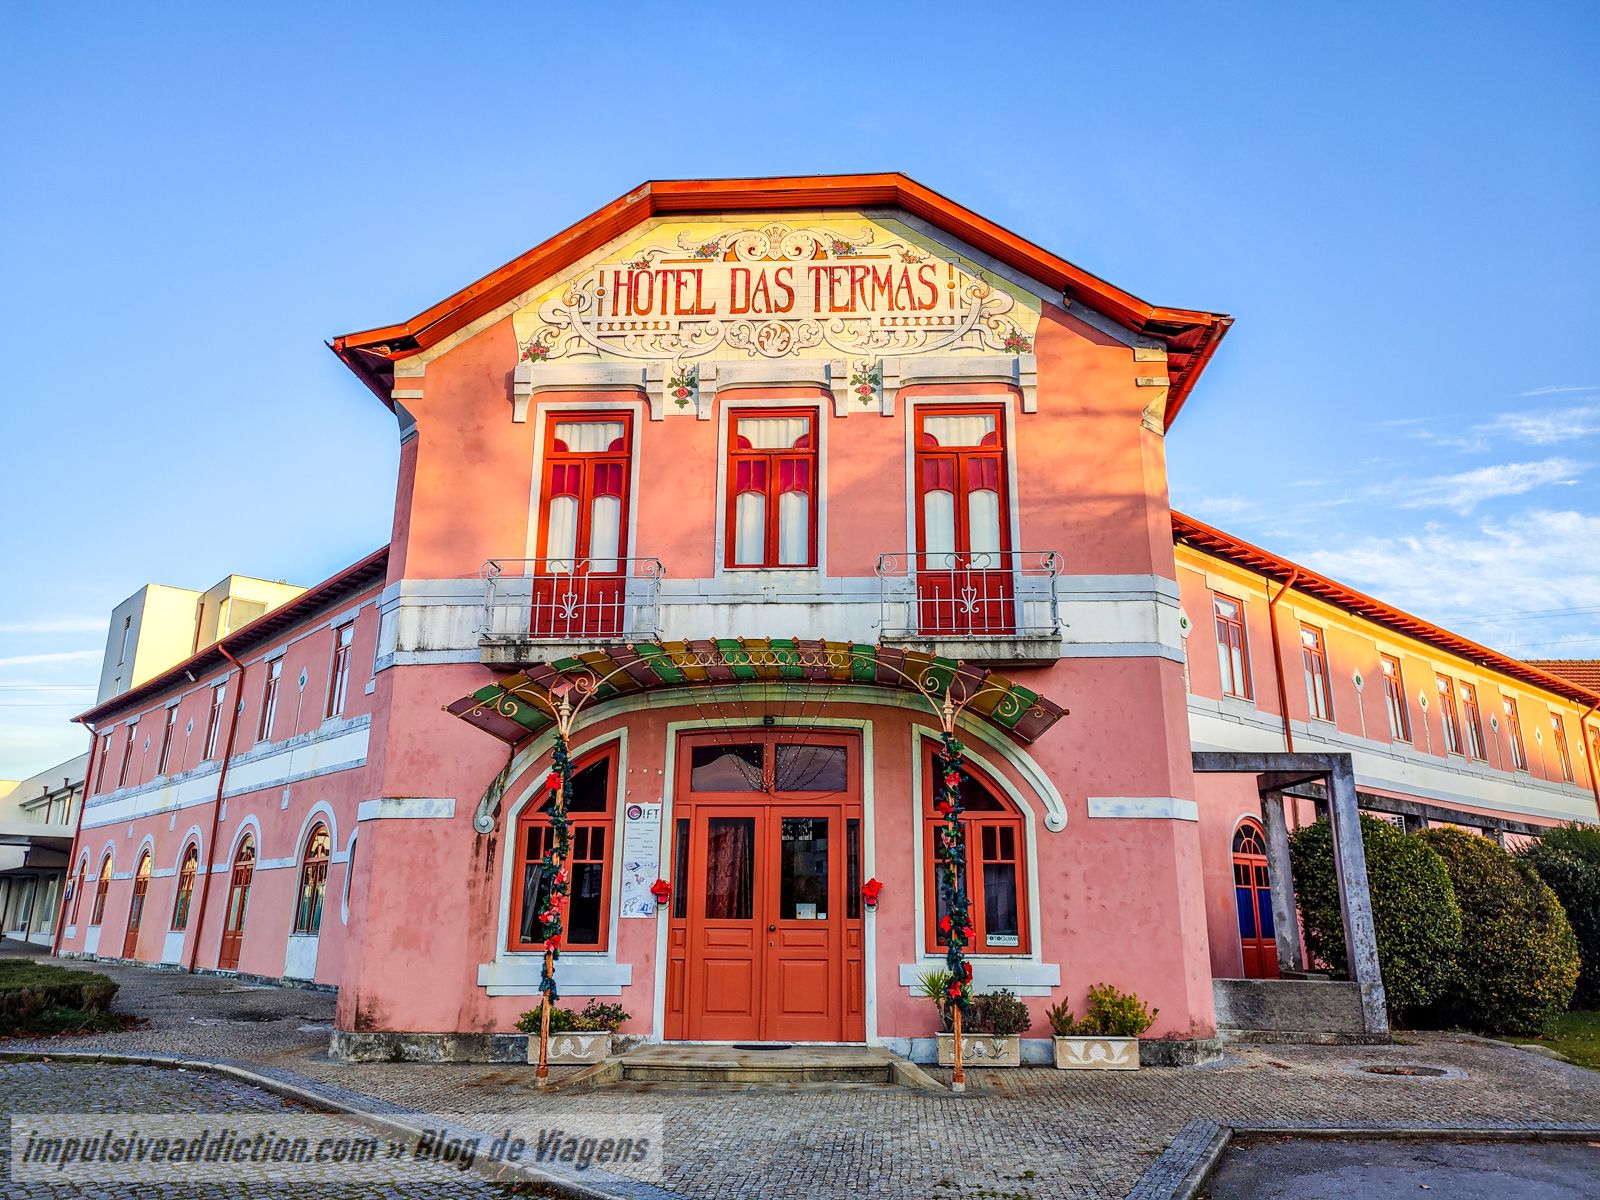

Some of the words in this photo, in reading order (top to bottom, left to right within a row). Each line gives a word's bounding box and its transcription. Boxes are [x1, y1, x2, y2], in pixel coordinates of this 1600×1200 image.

[611, 268, 716, 316] HOTEL
[729, 266, 795, 314] DAS
[808, 263, 939, 313] TERMAS
